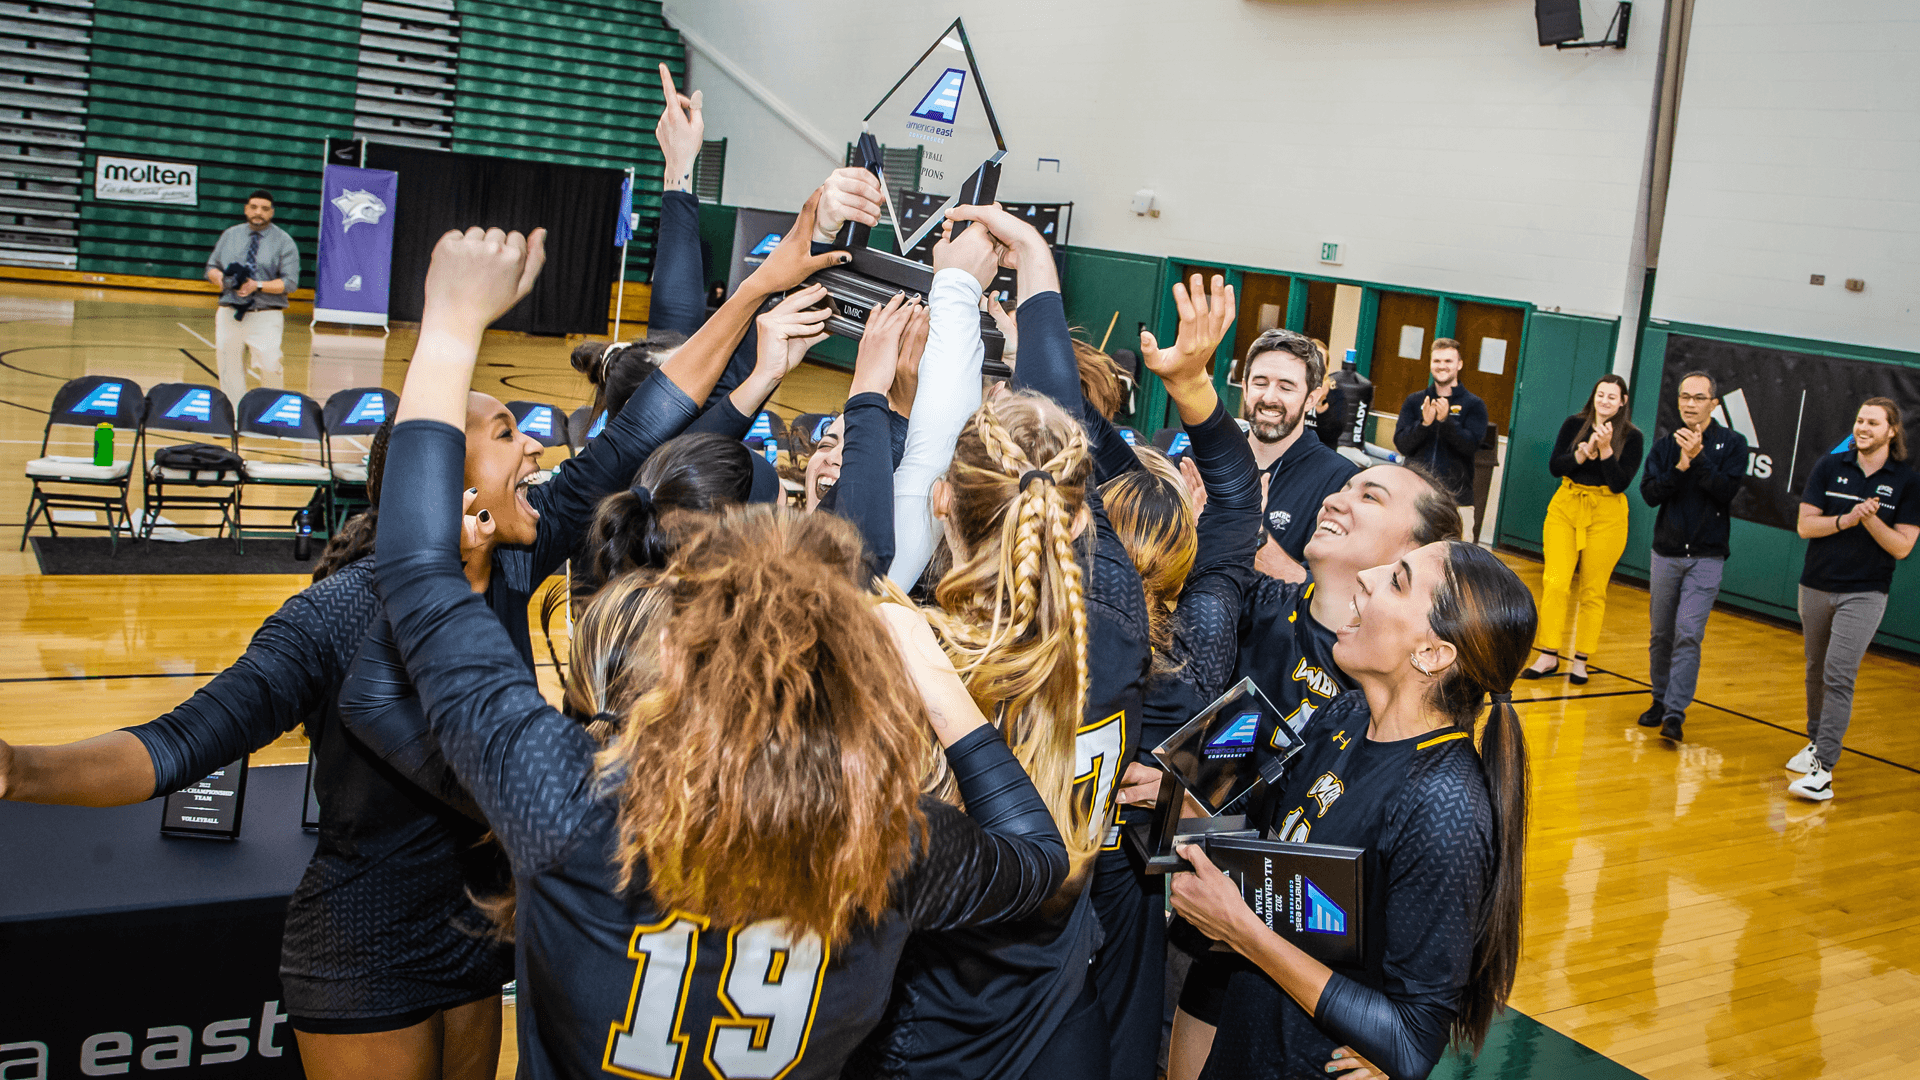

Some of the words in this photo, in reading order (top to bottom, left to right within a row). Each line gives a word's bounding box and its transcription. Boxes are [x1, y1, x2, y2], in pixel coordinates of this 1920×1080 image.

[906, 121, 935, 134] america
[936, 127, 953, 137] east
[909, 132, 945, 144] CONFERENCE
[104, 164, 191, 186] molten
[1321, 242, 1338, 261] EXIT
[843, 304, 863, 319] UMBC
[1353, 401, 1367, 443] READY
[187, 788, 234, 796] CHAMPIONSHIP
[181, 816, 219, 824] VOLLEYBALL
[1264, 857, 1273, 876] ALL
[1255, 887, 1263, 915] TEAM
[1275, 893, 1283, 912] 2022
[1295, 911, 1304, 932] east
[601, 909, 831, 1080] 19
[80, 999, 288, 1077] east
